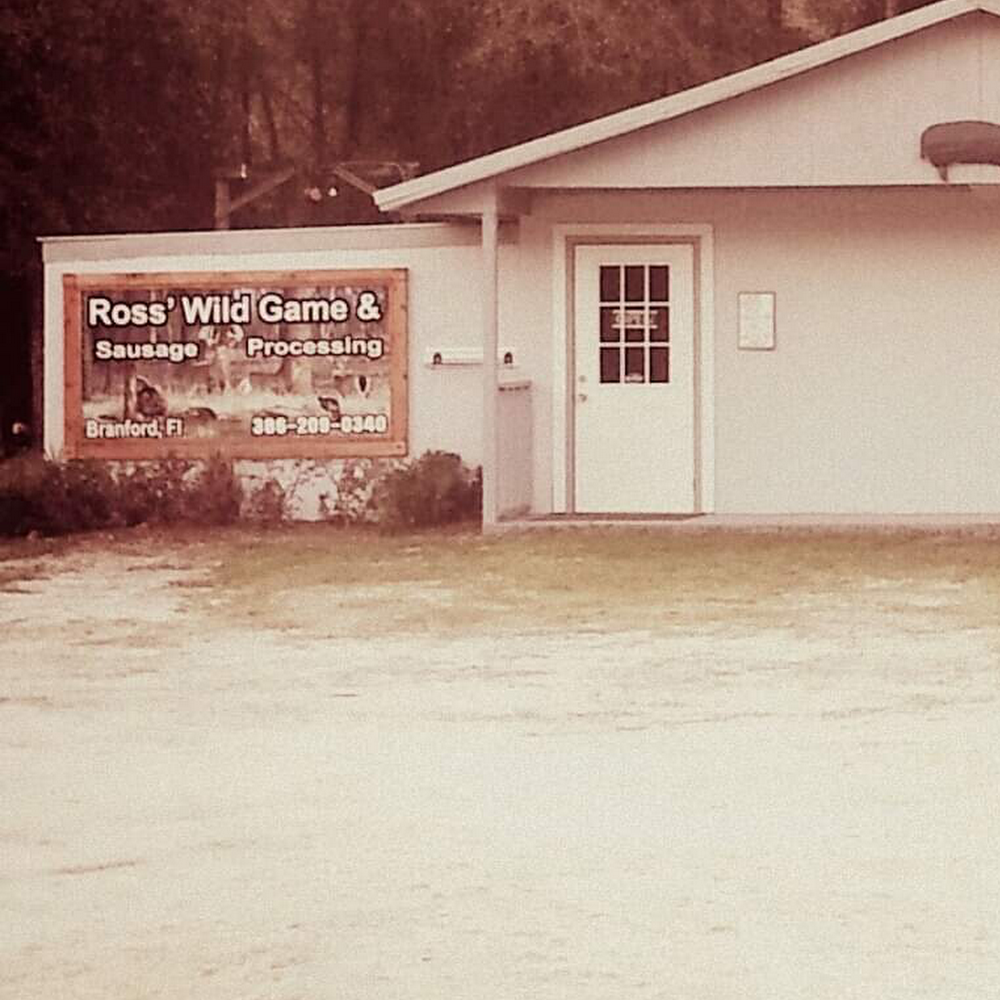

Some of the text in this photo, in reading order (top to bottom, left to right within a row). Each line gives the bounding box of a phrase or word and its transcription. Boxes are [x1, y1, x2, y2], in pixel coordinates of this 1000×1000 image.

[181, 294, 250, 324] Wild
[258, 294, 349, 323] Game
[356, 291, 382, 321] &
[95, 335, 383, 361] Sausage Processing
[85, 418, 162, 438] Branford,
